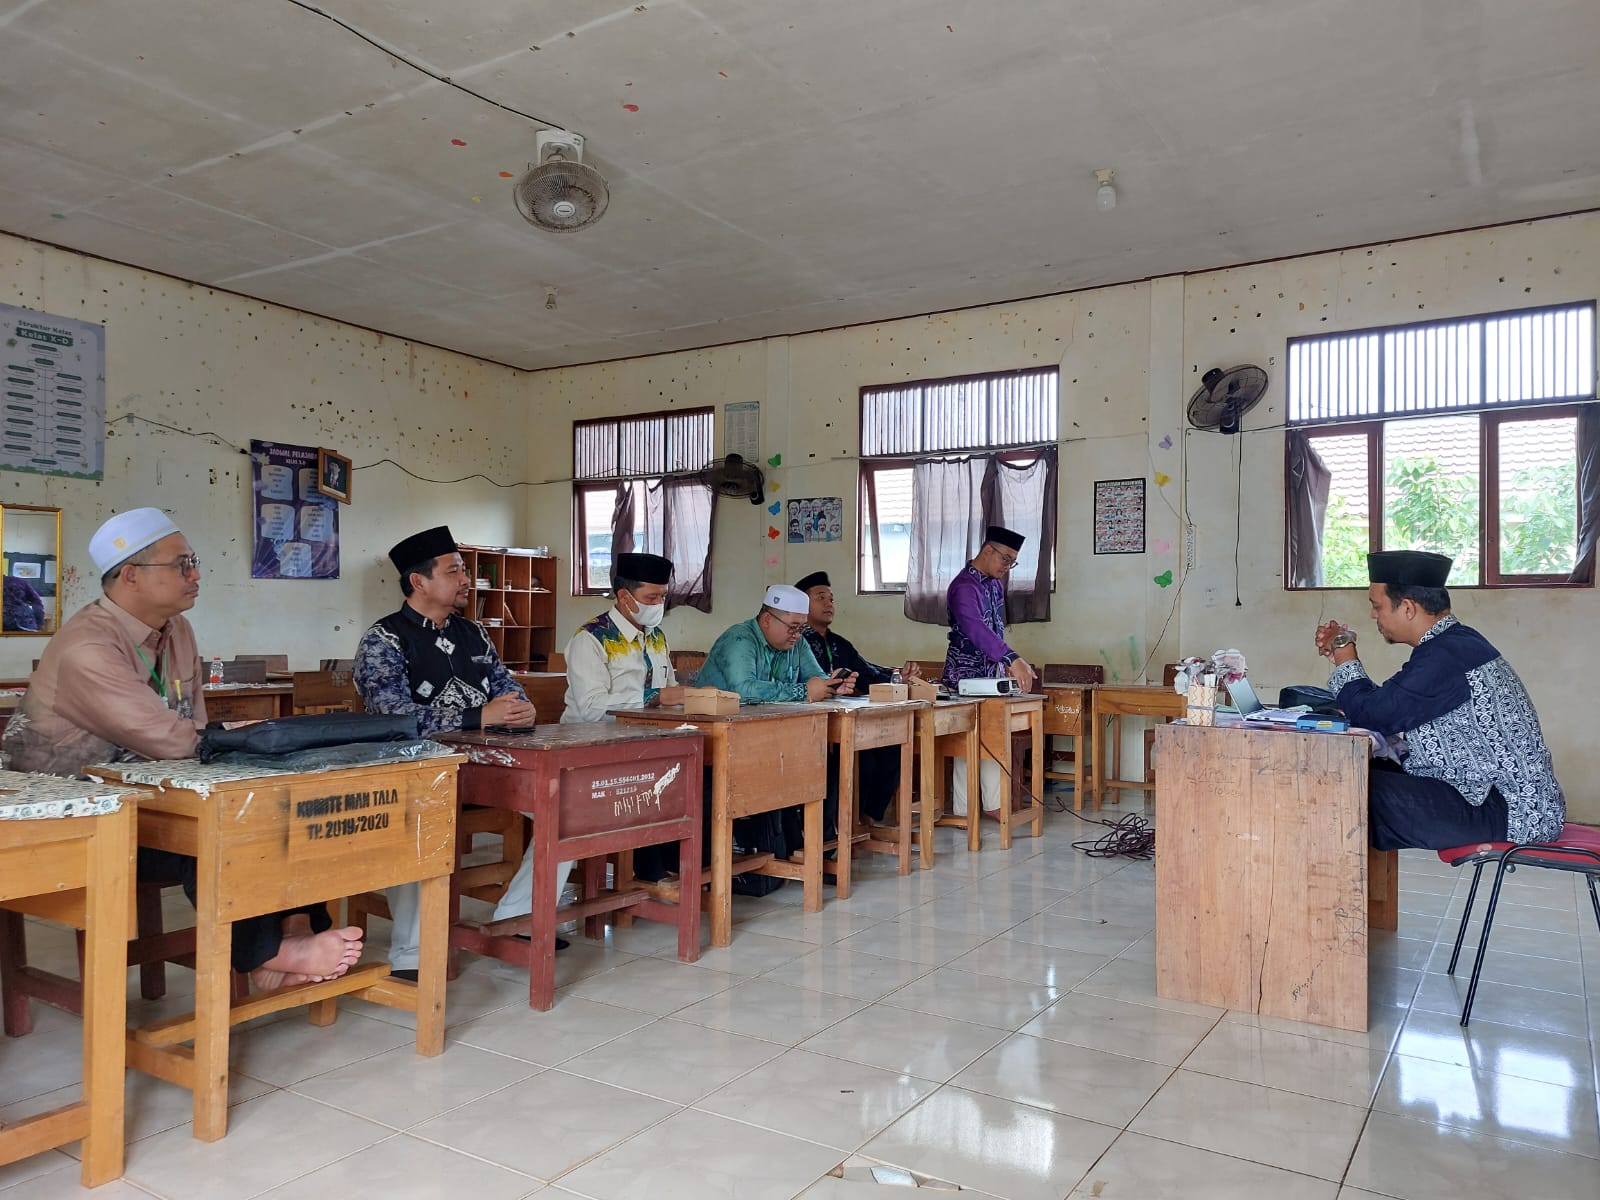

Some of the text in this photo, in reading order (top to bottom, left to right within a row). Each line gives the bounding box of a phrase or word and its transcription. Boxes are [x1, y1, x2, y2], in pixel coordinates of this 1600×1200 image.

[18, 320, 72, 336] Struktur Kelas
[21, 330, 69, 345] Kelas X-D
[269, 448, 290, 457] JADWAL
[296, 788, 399, 818] KOMITE MAN TALA
[325, 812, 390, 839] 2019/2020
